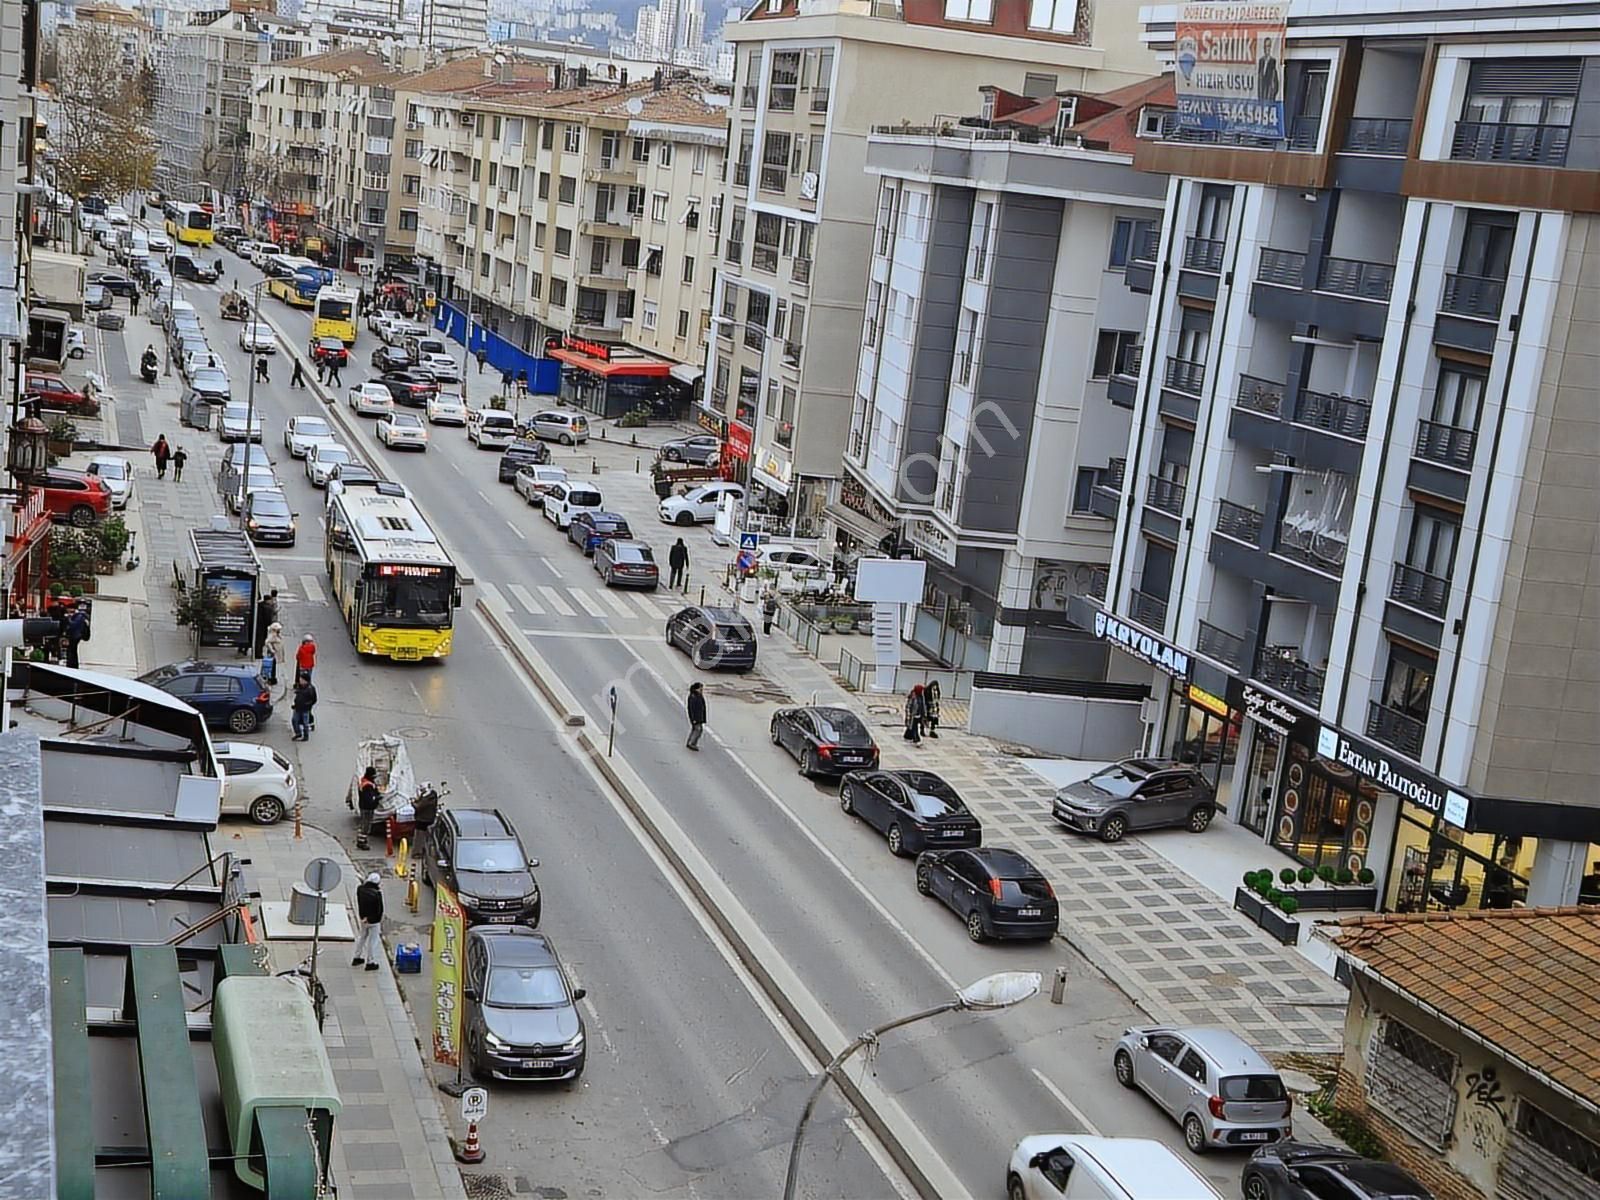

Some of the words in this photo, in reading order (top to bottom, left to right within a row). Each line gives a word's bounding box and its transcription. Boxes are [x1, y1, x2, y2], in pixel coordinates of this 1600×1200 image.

[1200, 29, 1253, 62] Satılık
[1226, 73, 1255, 92] USLU
[1106, 618, 1188, 675] KRYOLAN
[1338, 739, 1377, 778] ERTAN
